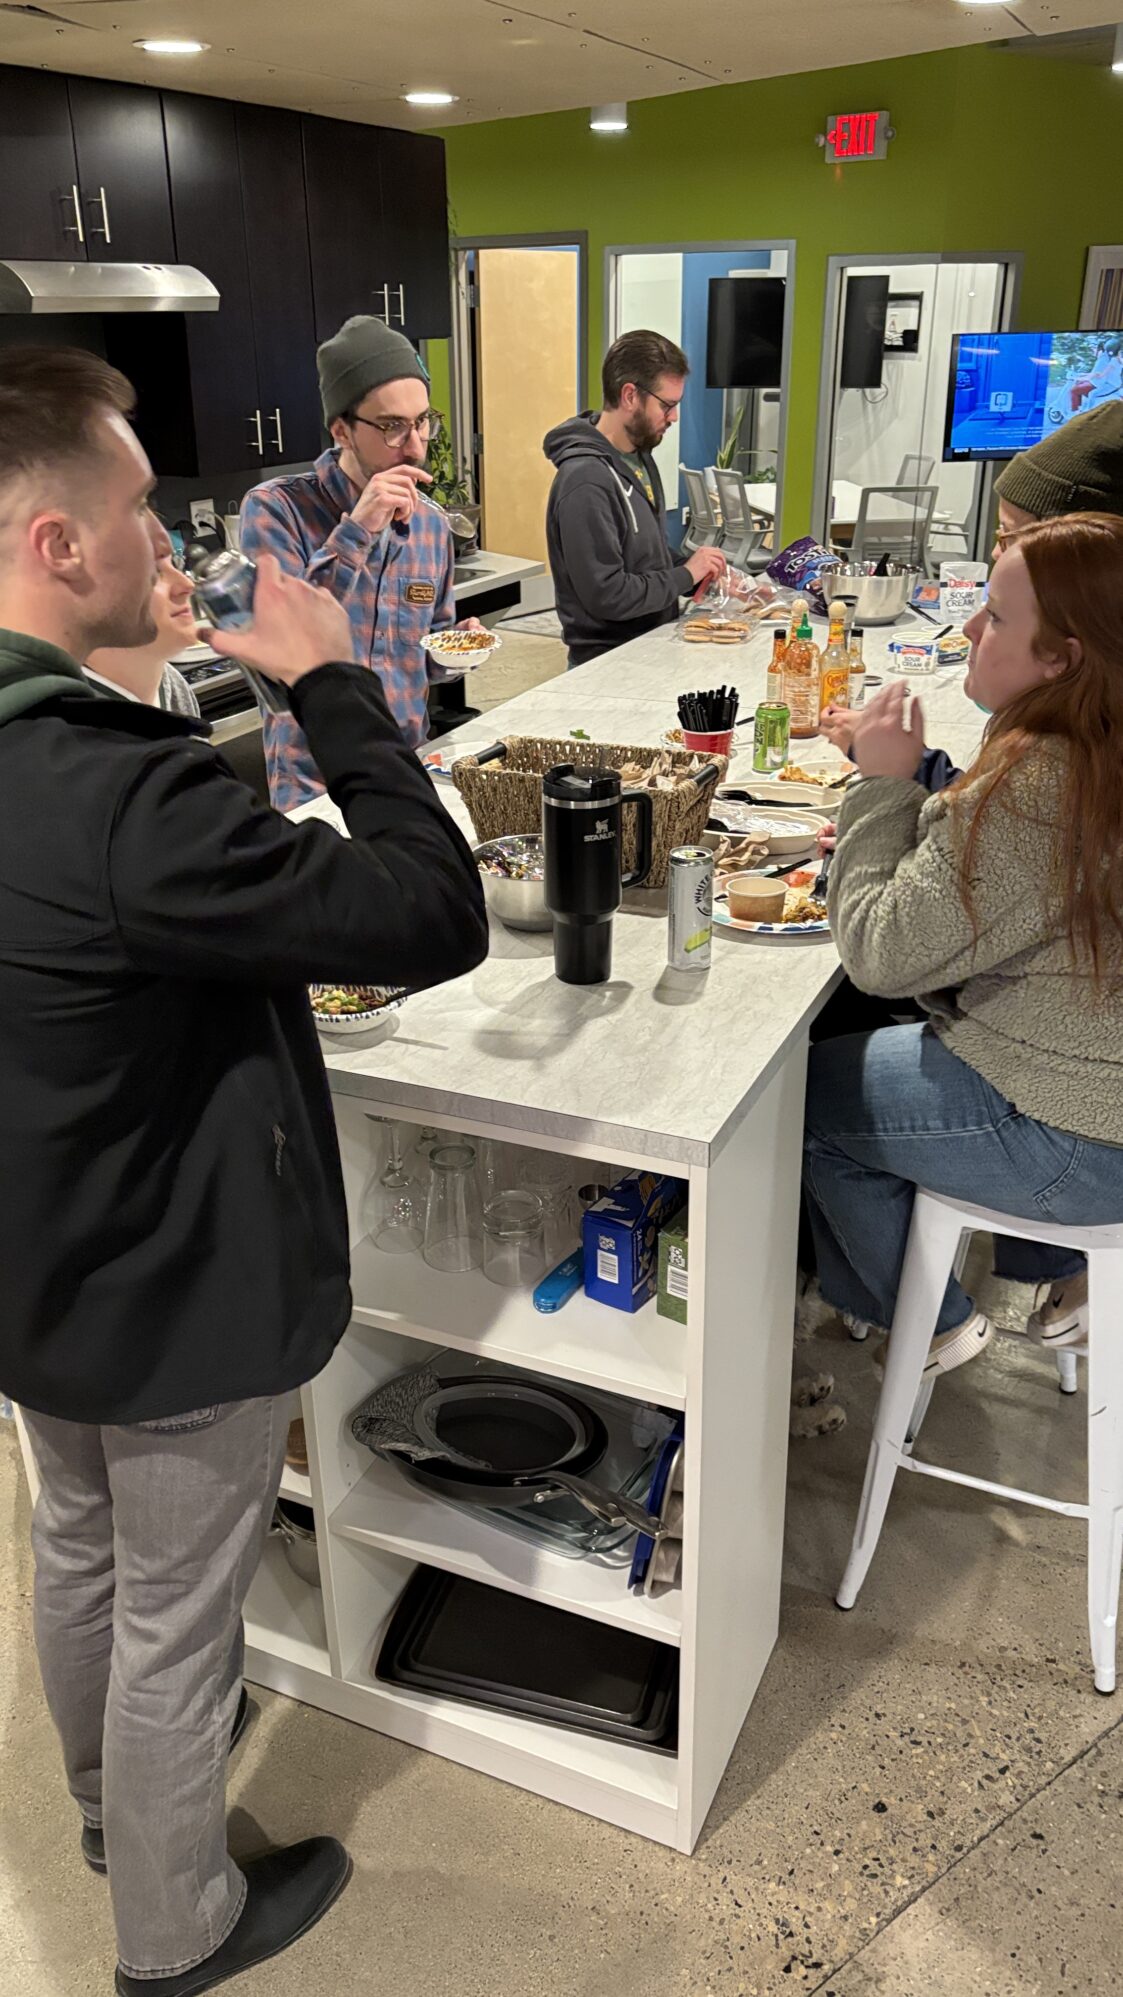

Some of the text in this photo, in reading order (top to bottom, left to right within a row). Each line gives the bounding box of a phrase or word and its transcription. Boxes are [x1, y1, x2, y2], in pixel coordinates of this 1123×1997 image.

[834, 112, 879, 156] EXIT
[948, 578, 976, 590] Daisy
[950, 591, 974, 600] SOUR
[946, 599, 975, 608] CREAM
[583, 831, 616, 842] STANLEY
